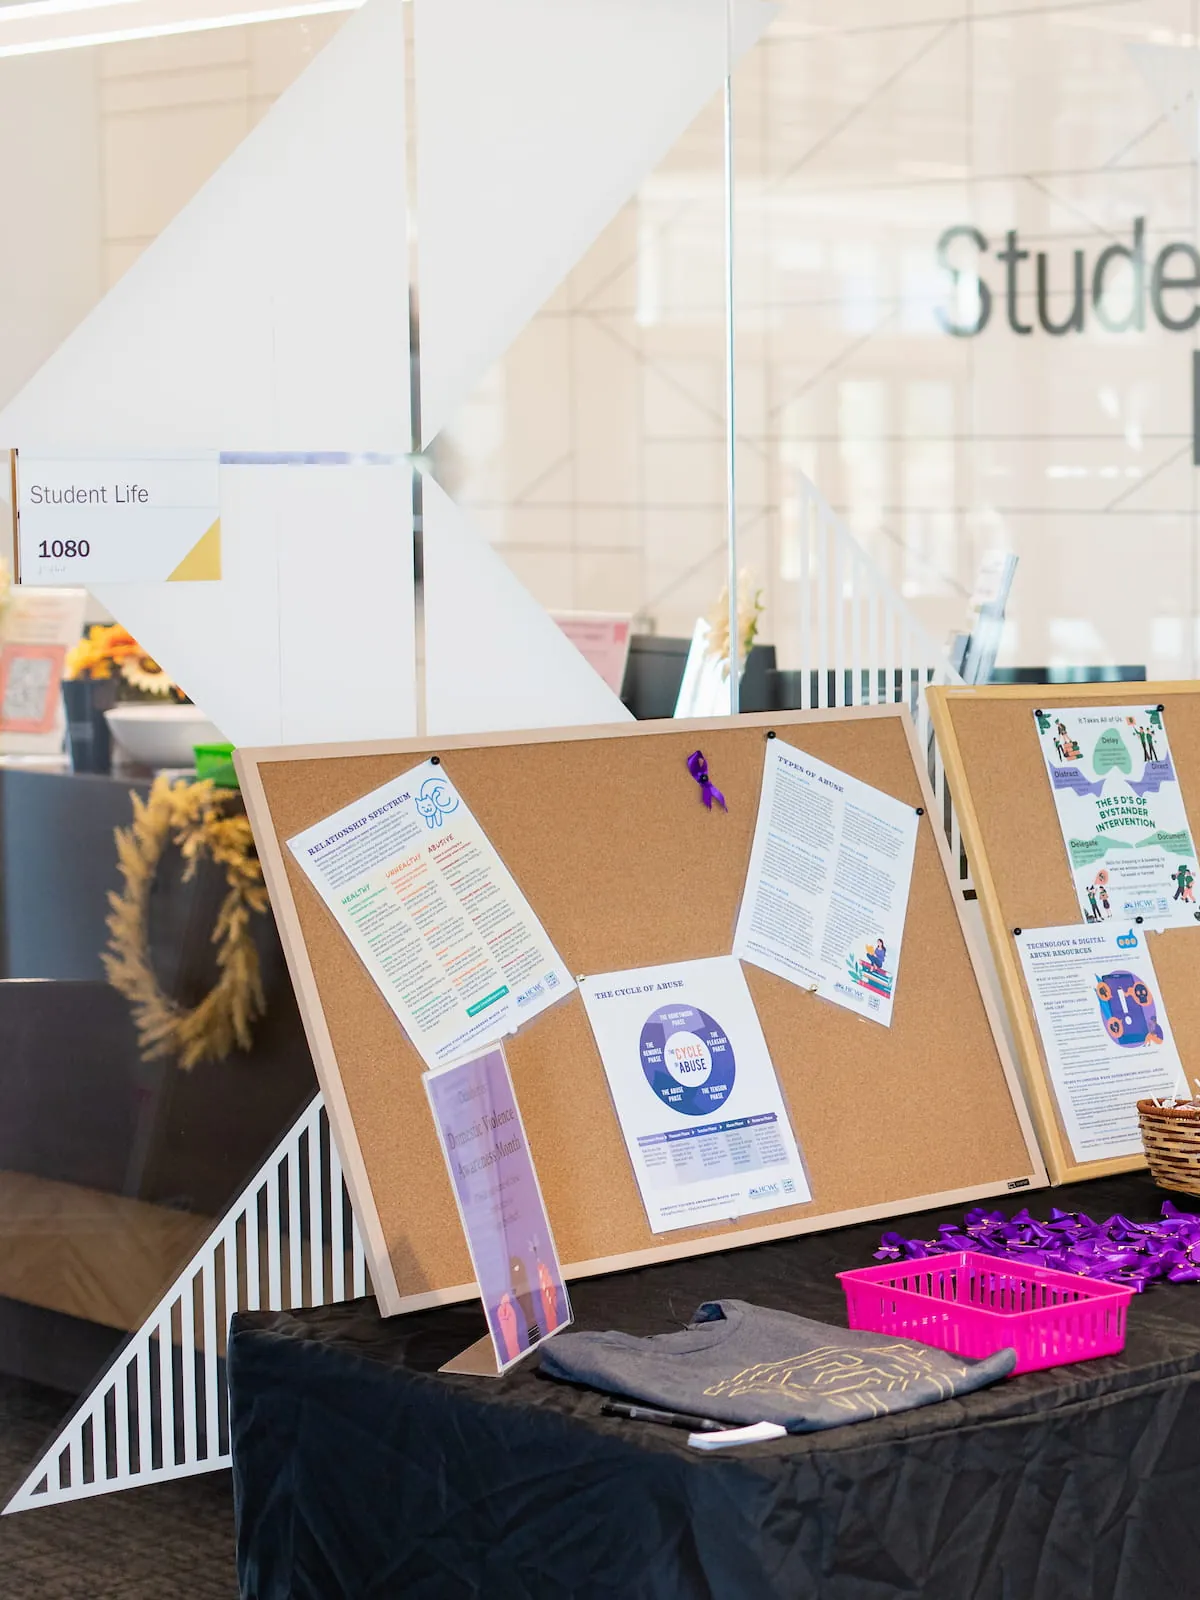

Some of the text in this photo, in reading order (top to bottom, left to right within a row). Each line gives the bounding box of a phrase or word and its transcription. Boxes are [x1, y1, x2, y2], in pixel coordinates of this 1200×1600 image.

[30, 484, 149, 504] Student Life
[38, 540, 90, 558] 1080
[1102, 736, 1119, 745] Delay
[1151, 762, 1168, 770] Direct
[776, 755, 805, 773] TYPES
[805, 769, 817, 779] OF
[817, 776, 844, 793] ABUSE
[1054, 770, 1079, 778] Distract
[1095, 796, 1147, 809] THE 5 D'S OF
[1099, 806, 1149, 820] BYSTANDER
[307, 817, 368, 856] RELATIONSHIP
[368, 791, 412, 821] SPECTRUM
[1095, 818, 1156, 833] INTERVENTION
[427, 833, 455, 853] ABUSIVE
[1070, 839, 1098, 849] Delegate
[1157, 832, 1186, 842] Document
[385, 853, 422, 879] UNHEALTHY
[341, 884, 371, 905] HEALTHY
[1027, 939, 1070, 950] TECHNOLOGY
[1078, 936, 1106, 945] DIGITAL
[1030, 947, 1092, 959] ABUSE RESOURCES
[594, 980, 684, 1000] THE CYCLE OF ABUSE
[706, 1037, 727, 1046] PLEASANT
[712, 1045, 726, 1053] PHASE
[675, 1044, 703, 1060] CYCLE
[679, 1058, 707, 1074] ABUSE
[448, 1108, 515, 1150] Domestic Violence
[458, 1133, 521, 1179] Awareness Month
